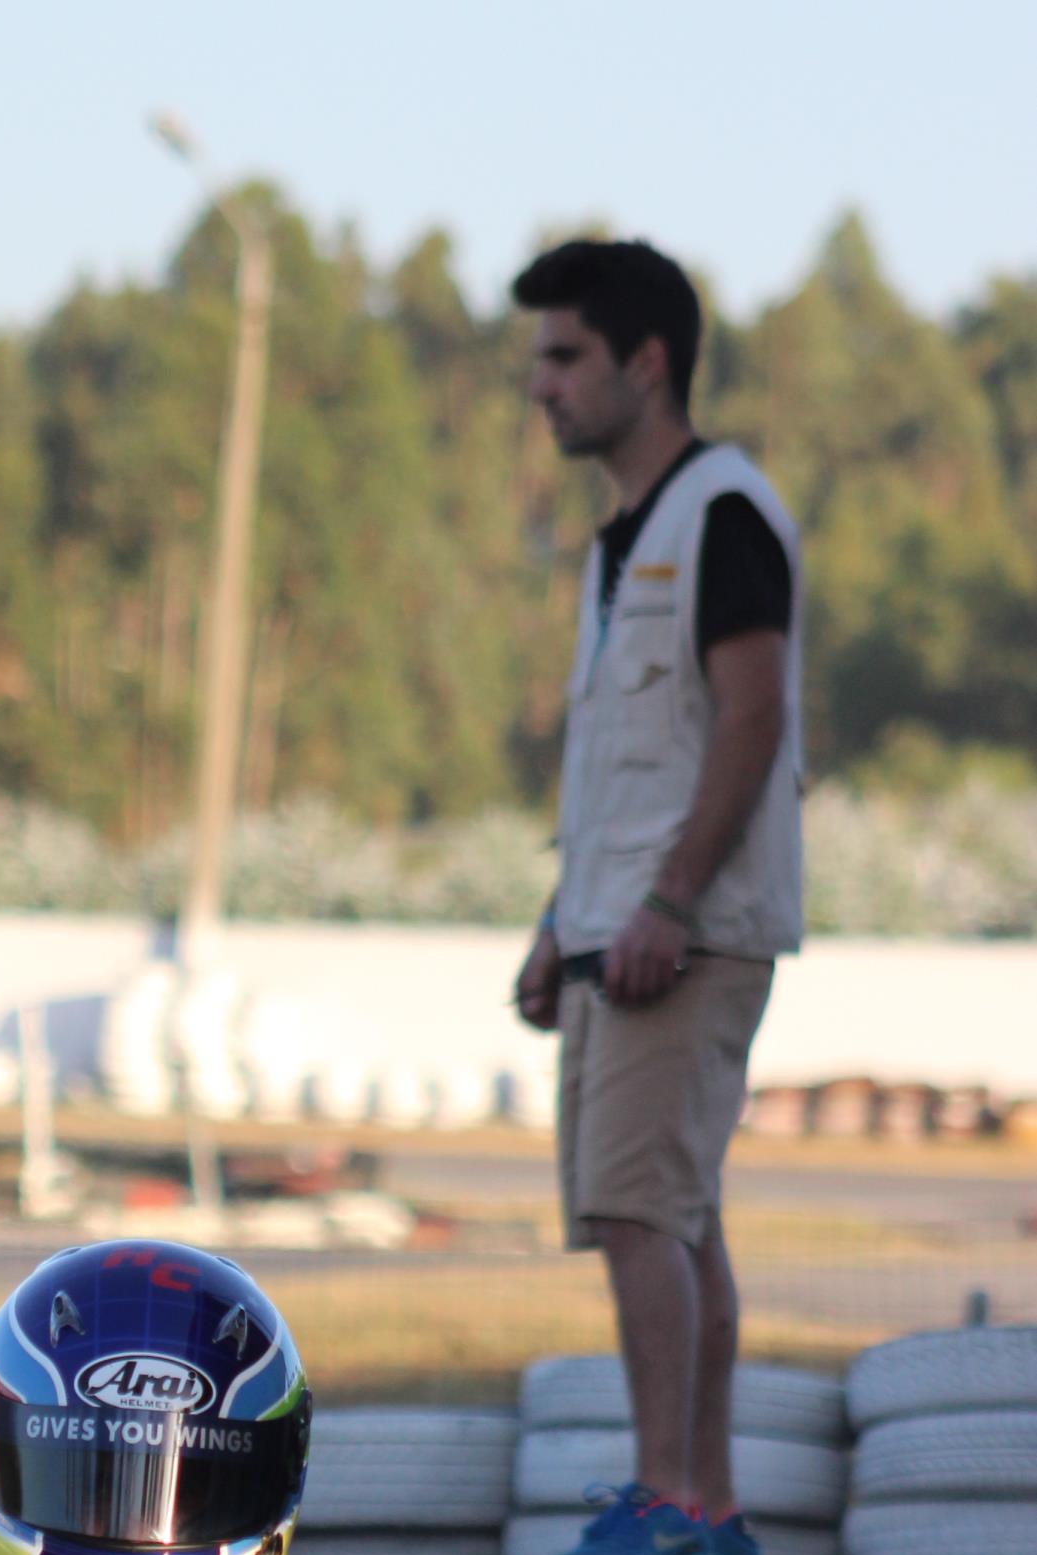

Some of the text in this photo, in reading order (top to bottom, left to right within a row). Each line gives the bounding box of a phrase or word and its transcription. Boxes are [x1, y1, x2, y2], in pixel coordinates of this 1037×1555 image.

[85, 1361, 198, 1401] Arai
[26, 1415, 253, 1453] GIVES YOU WINGS
